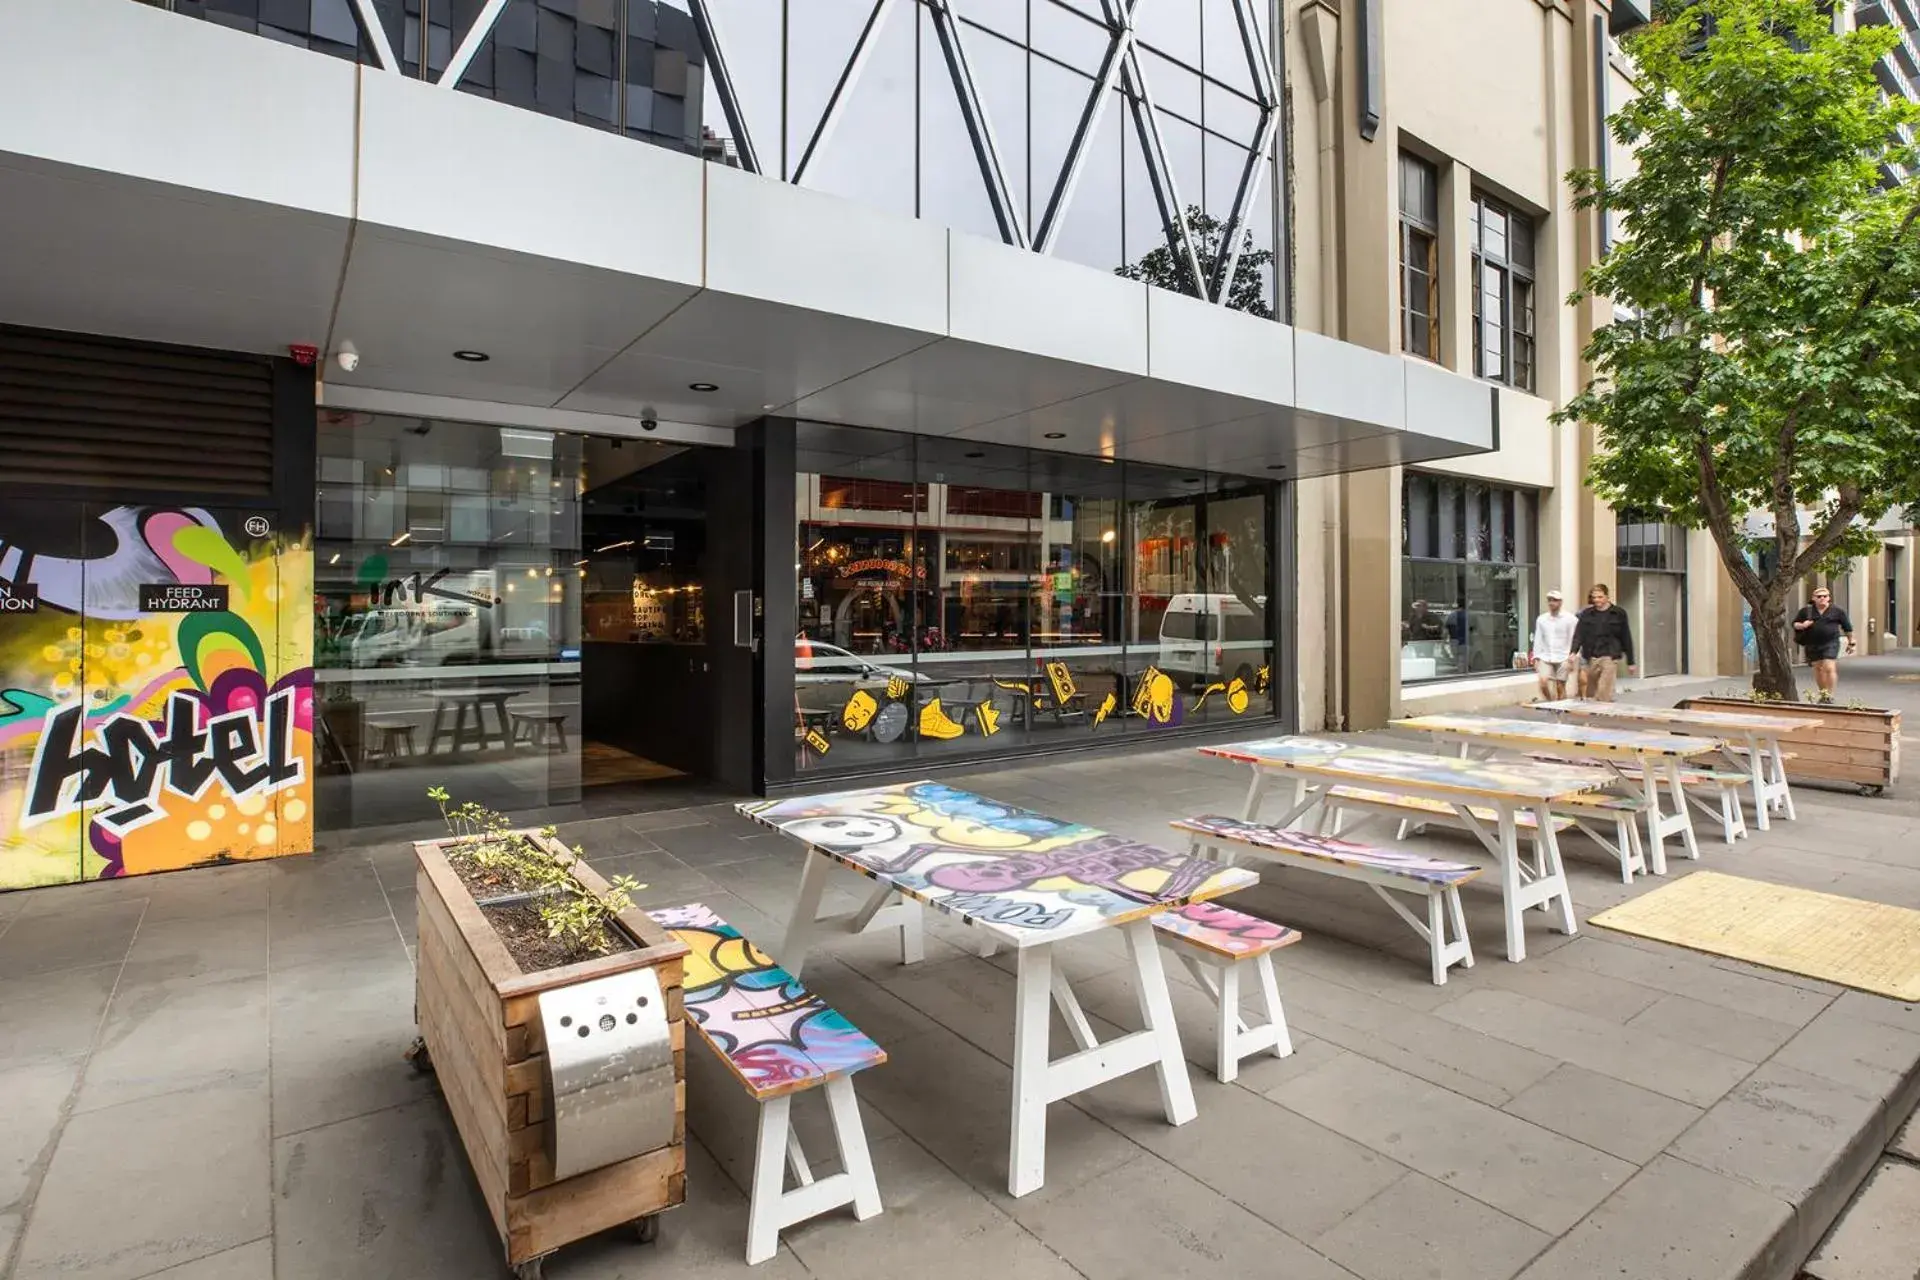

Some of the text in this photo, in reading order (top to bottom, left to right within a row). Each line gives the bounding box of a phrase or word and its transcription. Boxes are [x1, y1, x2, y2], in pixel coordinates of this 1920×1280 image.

[166, 587, 202, 599] FEED
[148, 598, 220, 609] HYDRANT
[18, 686, 306, 832] hotel
